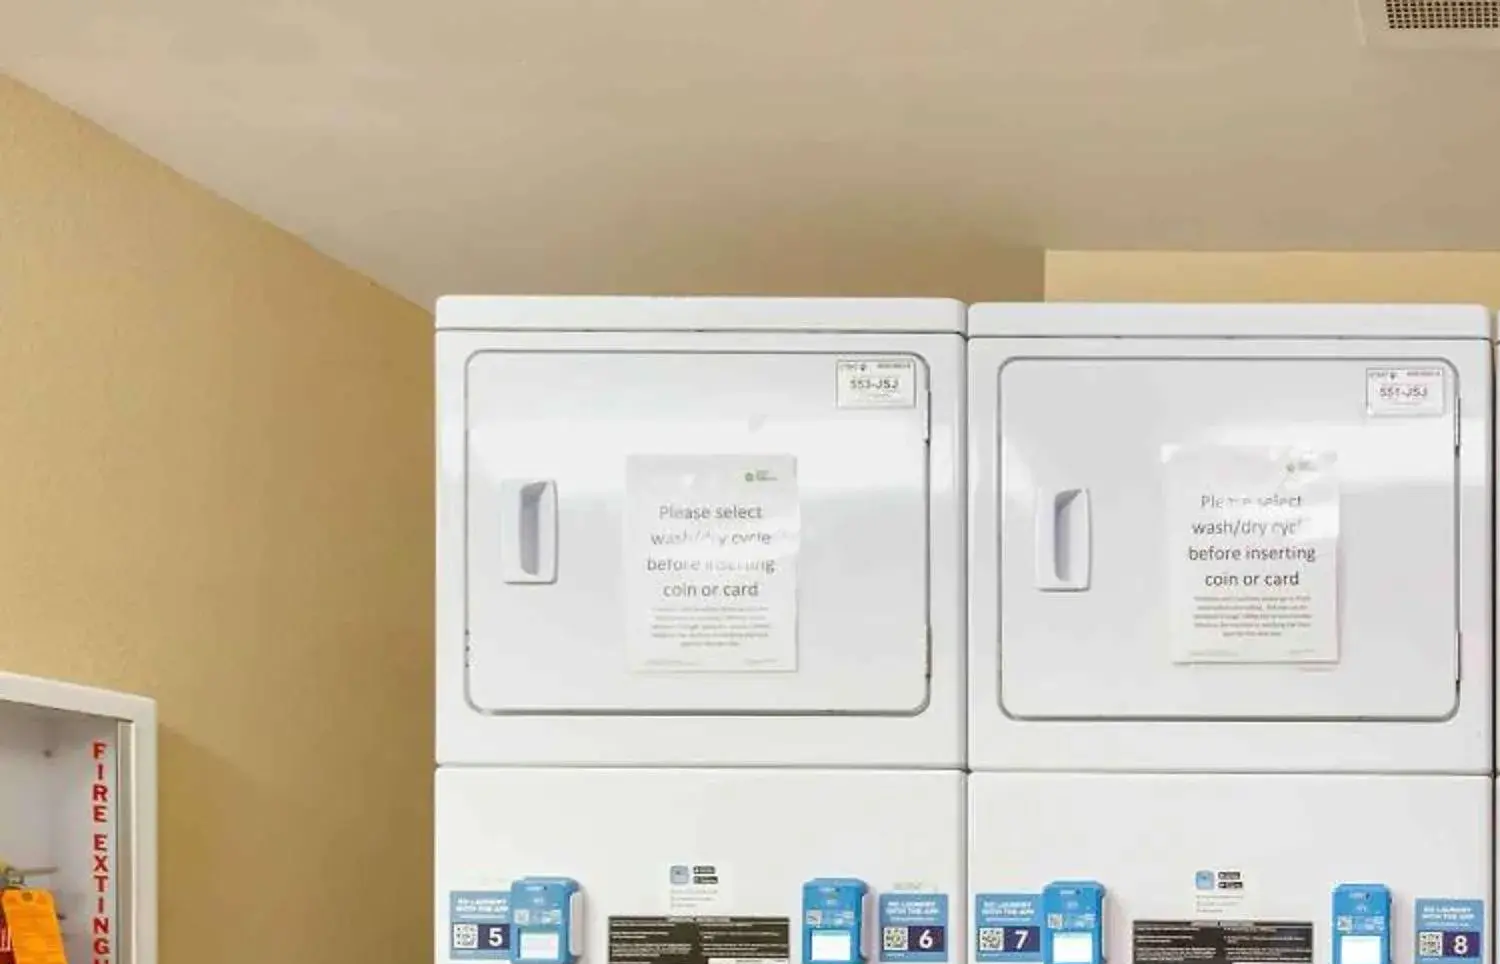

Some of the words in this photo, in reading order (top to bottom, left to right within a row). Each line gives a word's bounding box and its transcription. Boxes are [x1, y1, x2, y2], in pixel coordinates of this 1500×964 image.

[659, 505, 710, 519] Please
[716, 505, 763, 519] select
[1192, 520, 1267, 536] wash/dry
[1188, 546, 1241, 561] before
[1246, 546, 1316, 562] inserting
[1205, 573, 1239, 587] coin
[1244, 574, 1259, 587] or
[1264, 571, 1300, 587] card
[663, 583, 697, 597] coin
[701, 584, 718, 597] or
[723, 582, 759, 597] card
[92, 742, 108, 823] FIRE
[489, 928, 503, 947] 5
[920, 930, 933, 948] 6
[1015, 930, 1028, 949] 7
[1454, 935, 1468, 954] 8
